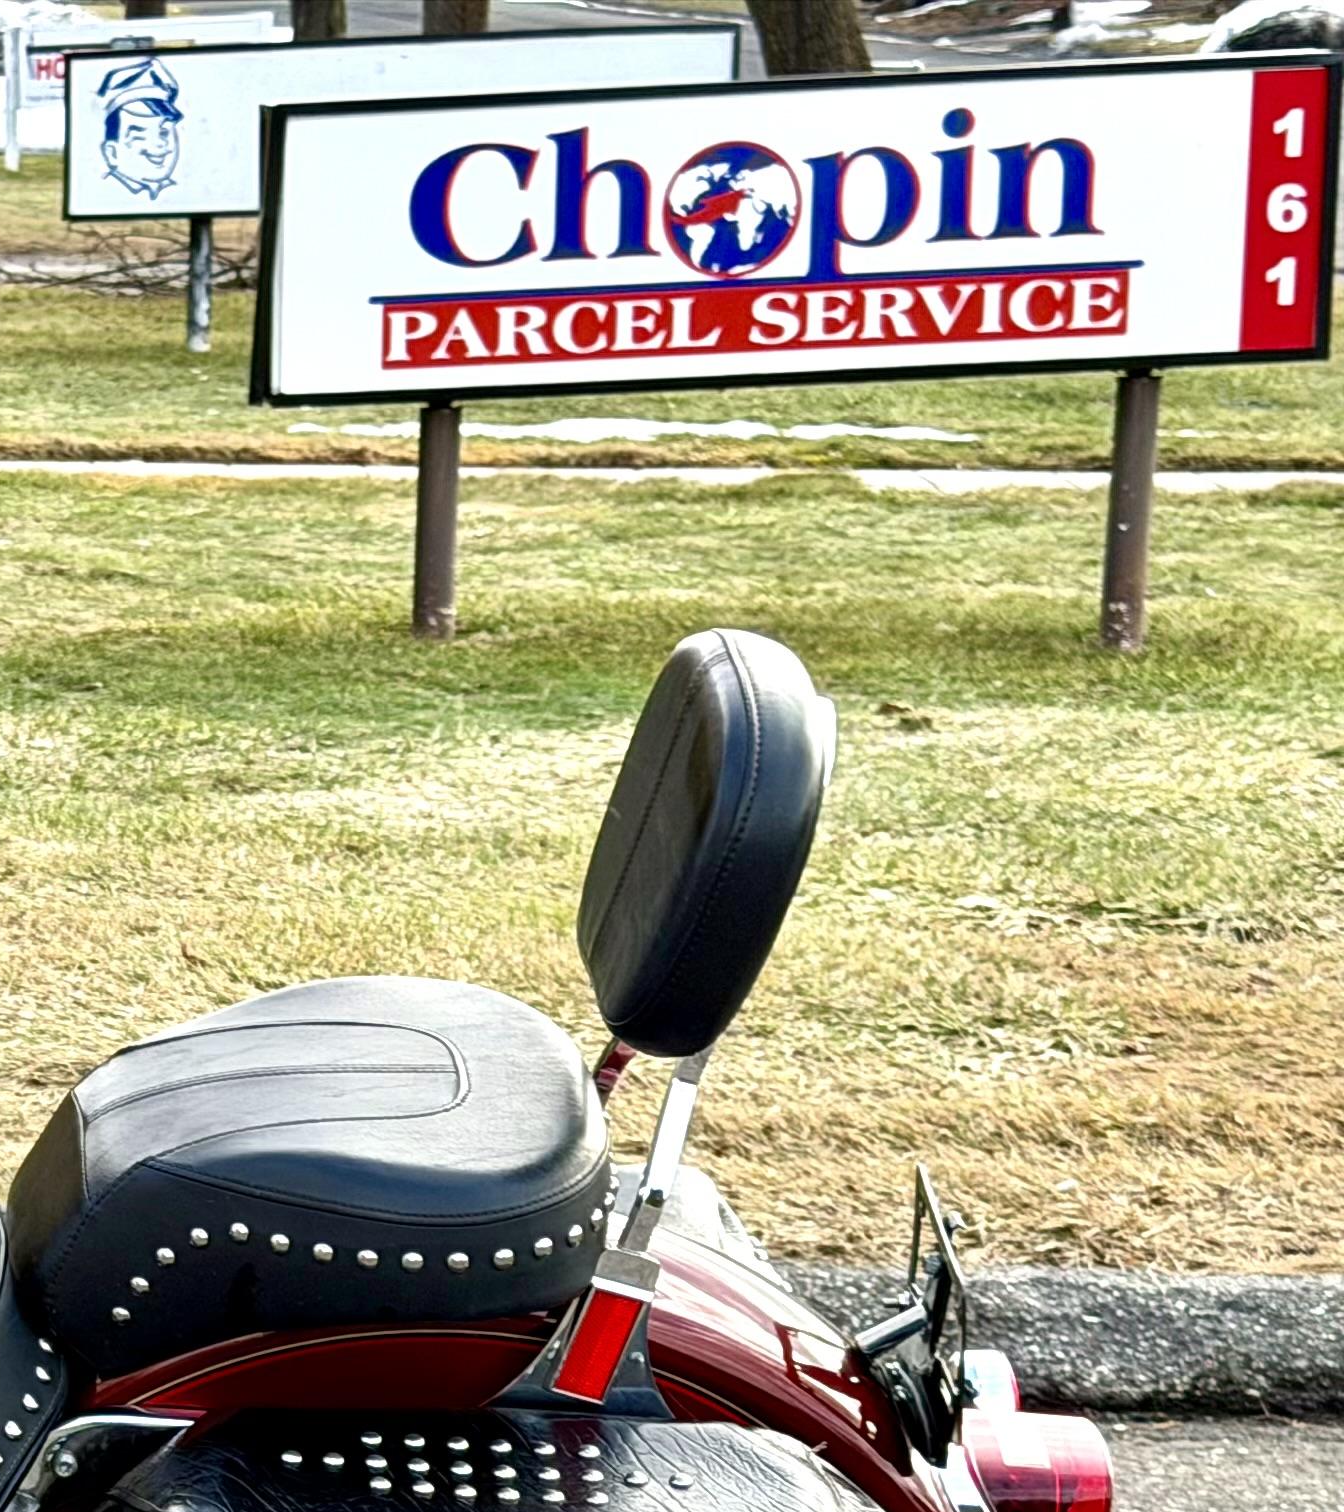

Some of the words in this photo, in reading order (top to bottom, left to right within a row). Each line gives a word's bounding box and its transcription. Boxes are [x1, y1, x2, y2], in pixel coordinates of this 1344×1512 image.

[409, 107, 1104, 280] Chopin
[385, 297, 722, 361] PARCEL
[748, 278, 1123, 346] SERVICE
